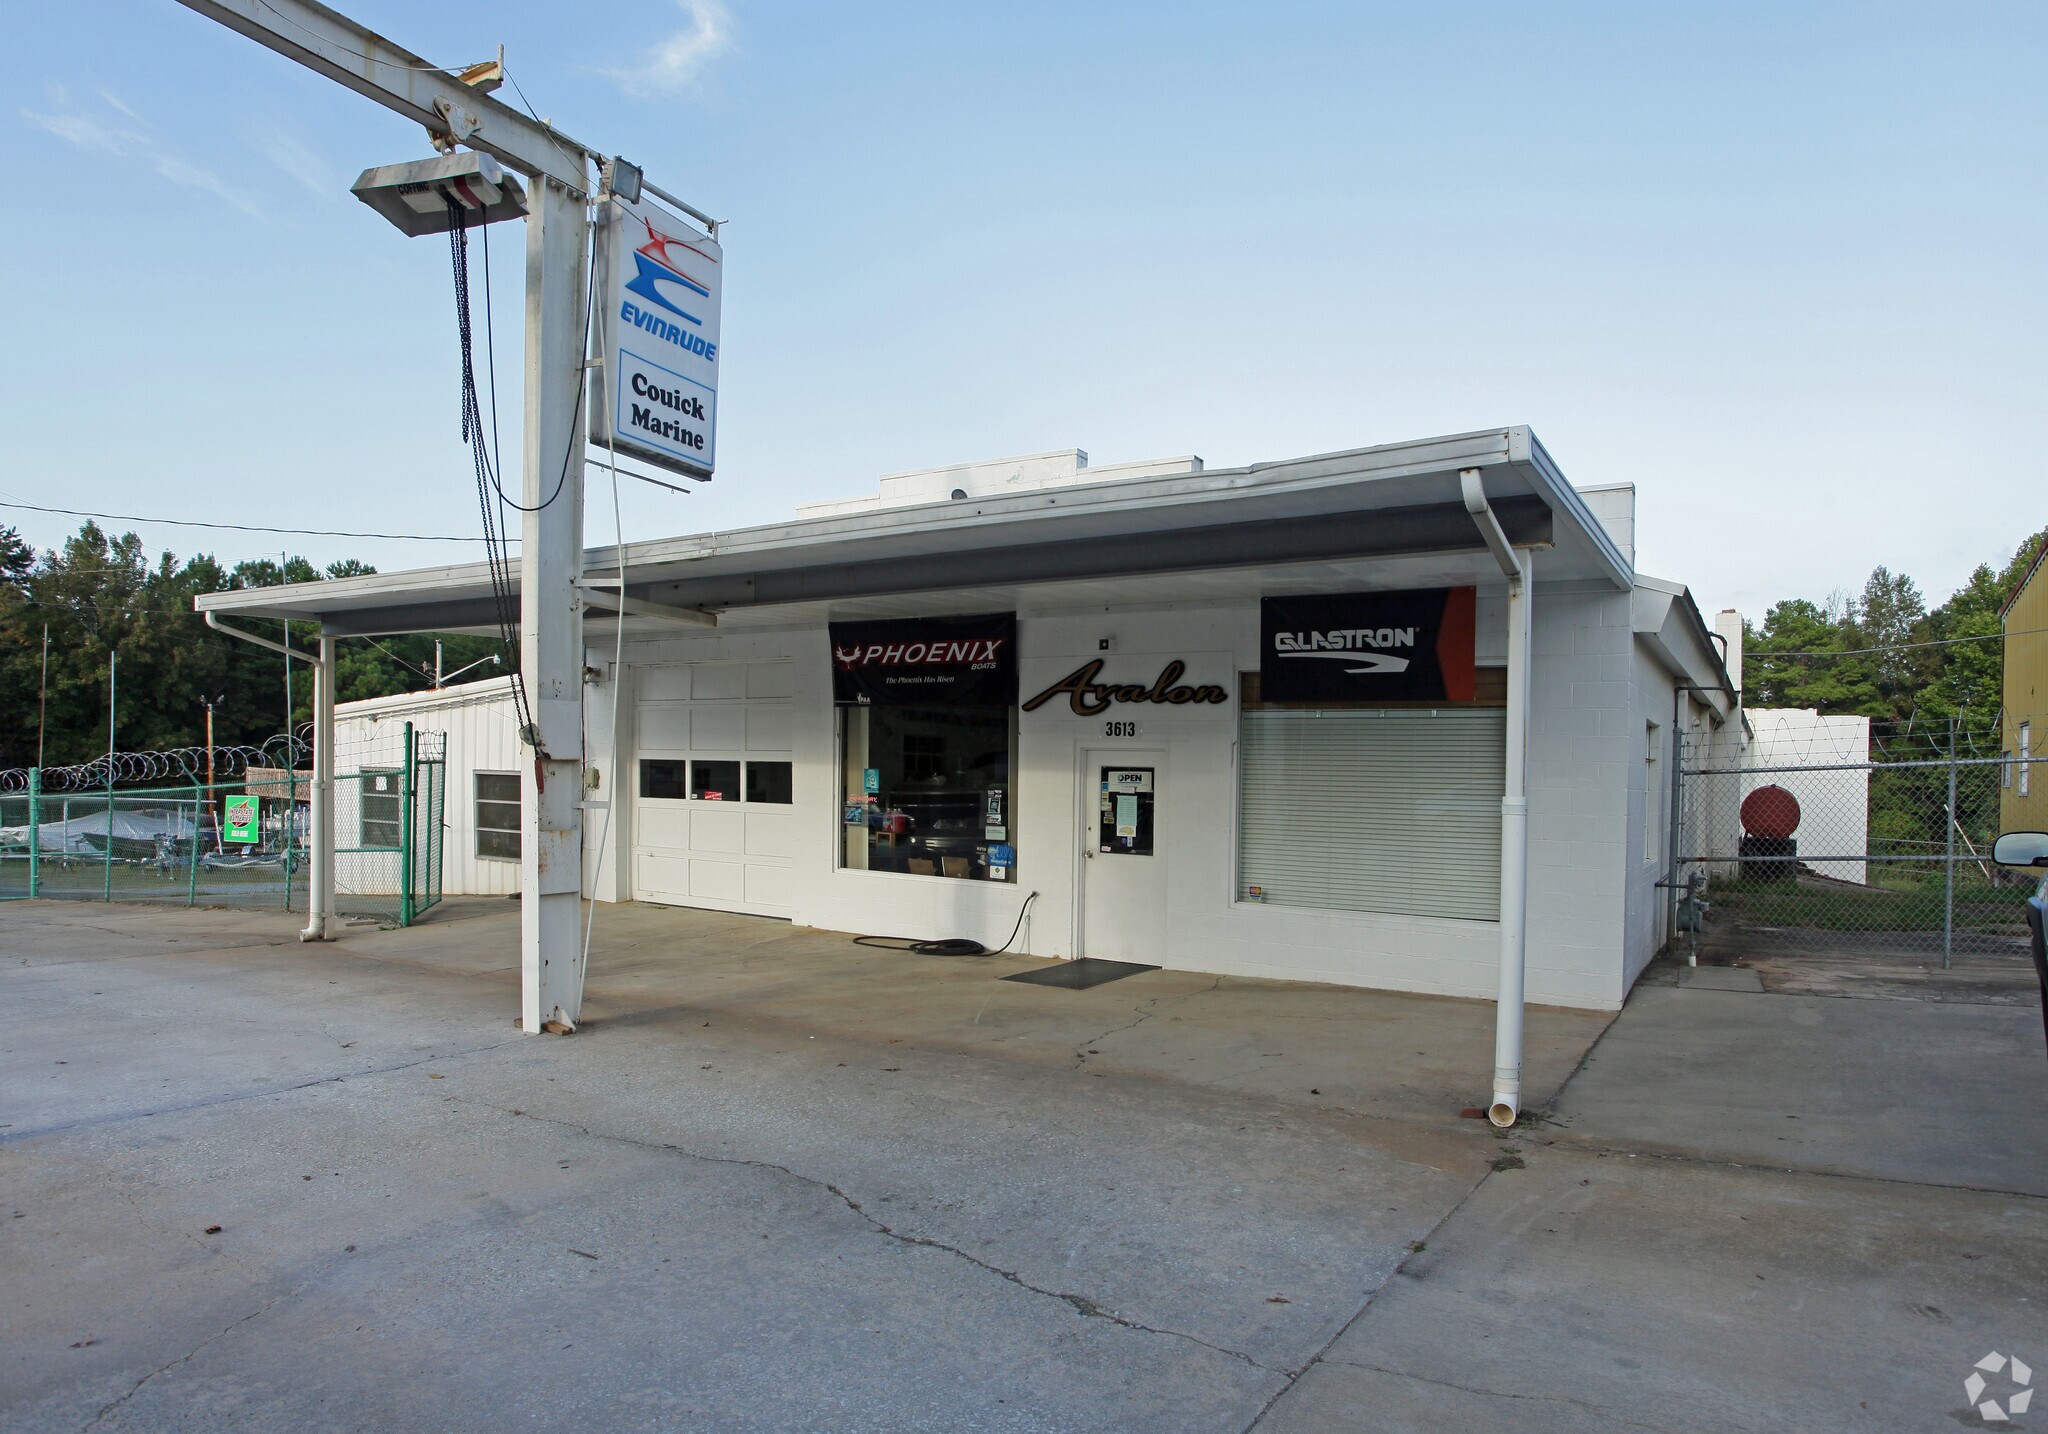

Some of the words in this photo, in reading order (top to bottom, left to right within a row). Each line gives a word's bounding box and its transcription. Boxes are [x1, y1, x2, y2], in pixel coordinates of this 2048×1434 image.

[620, 300, 717, 362] EVINRUDE
[631, 372, 706, 421] Couick
[630, 403, 705, 451] Marine
[1274, 627, 1415, 651] GLASTRON
[862, 640, 1003, 665] PHOENIX
[970, 662, 997, 671] BOATS
[885, 677, 897, 685] The
[898, 675, 922, 684] Phoenix
[923, 676, 936, 684] Has
[937, 675, 955, 683] Risen
[1021, 658, 1229, 716] Avalon
[1105, 721, 1136, 737] 3613
[1117, 774, 1143, 782] OPEN
[228, 807, 254, 816] INTERSTATE
[228, 815, 252, 823] BATTERIES
